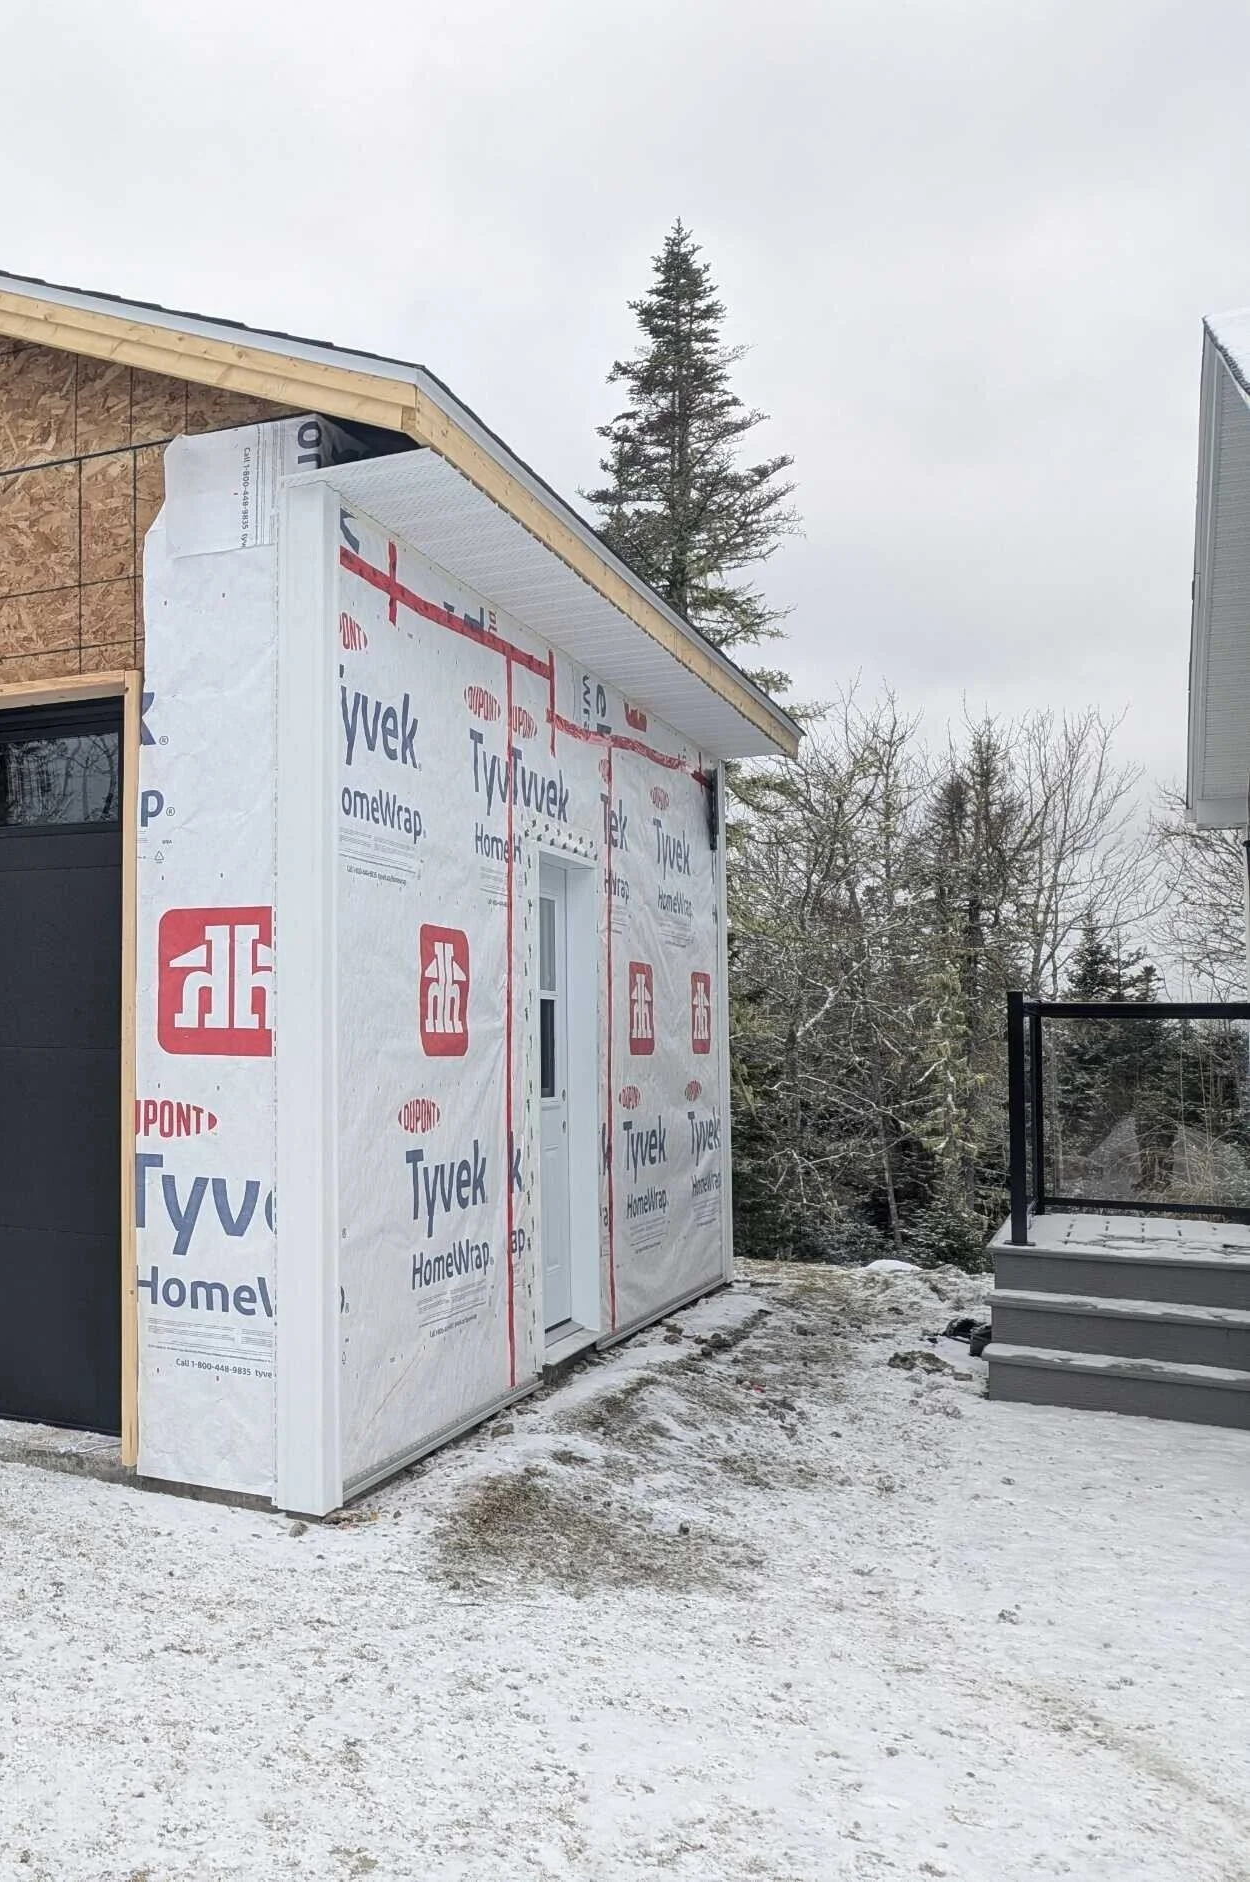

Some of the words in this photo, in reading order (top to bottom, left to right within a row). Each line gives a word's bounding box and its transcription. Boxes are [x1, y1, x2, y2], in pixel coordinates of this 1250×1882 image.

[341, 786, 423, 844] omeWrap
[653, 818, 691, 881] Tyvek
[403, 1098, 436, 1133] DUPONT
[623, 1115, 667, 1184] Tyvek
[136, 1153, 273, 1256] Tyv
[405, 1139, 487, 1238] Tyvek
[626, 1187, 667, 1219] HomeWrap
[411, 1239, 490, 1290] HomeWrap
[176, 1358, 190, 1368] Call
[191, 1360, 251, 1376] 1-800-448-9835
